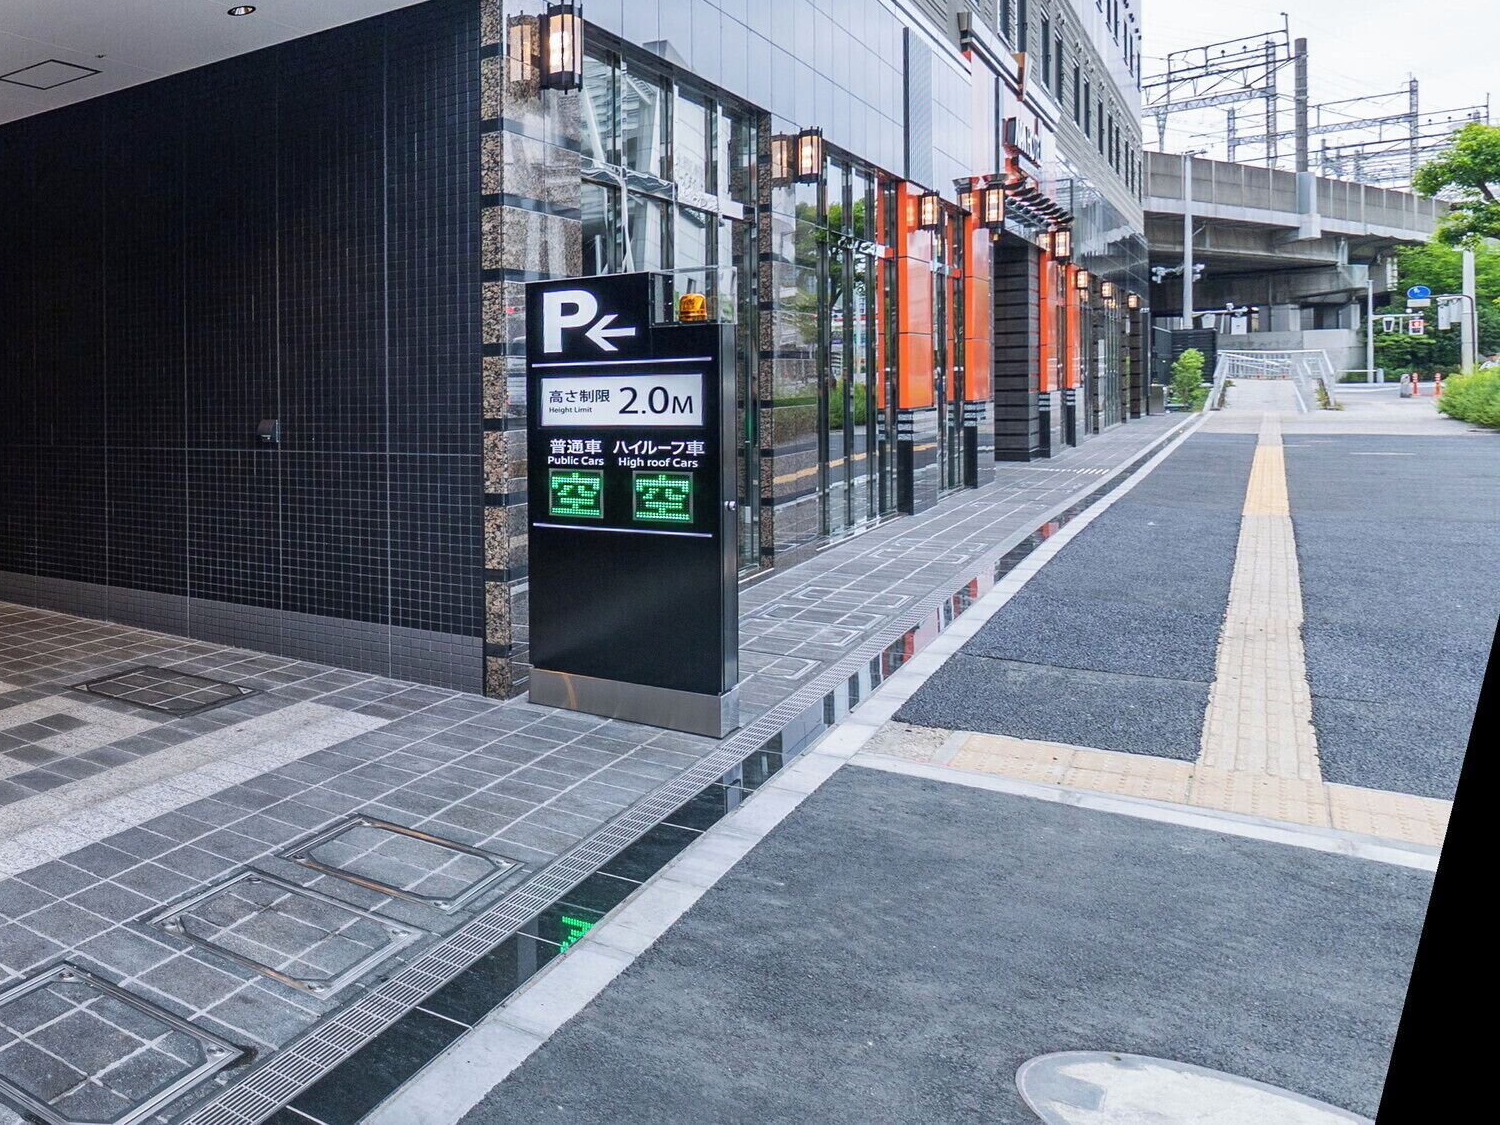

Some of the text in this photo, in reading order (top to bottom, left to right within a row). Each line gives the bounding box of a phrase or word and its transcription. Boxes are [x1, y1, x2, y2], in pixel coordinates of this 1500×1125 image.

[543, 289, 598, 354] P
[549, 389, 610, 404] 高さ制限
[618, 386, 694, 415] 2.0M
[549, 406, 572, 415] Height
[550, 439, 602, 455] 普通車
[612, 440, 705, 456] ハイルーフ車
[547, 456, 604, 466] Public Cars
[618, 457, 698, 468] High roof Cars
[551, 472, 600, 516] 空
[635, 474, 690, 520] 空
